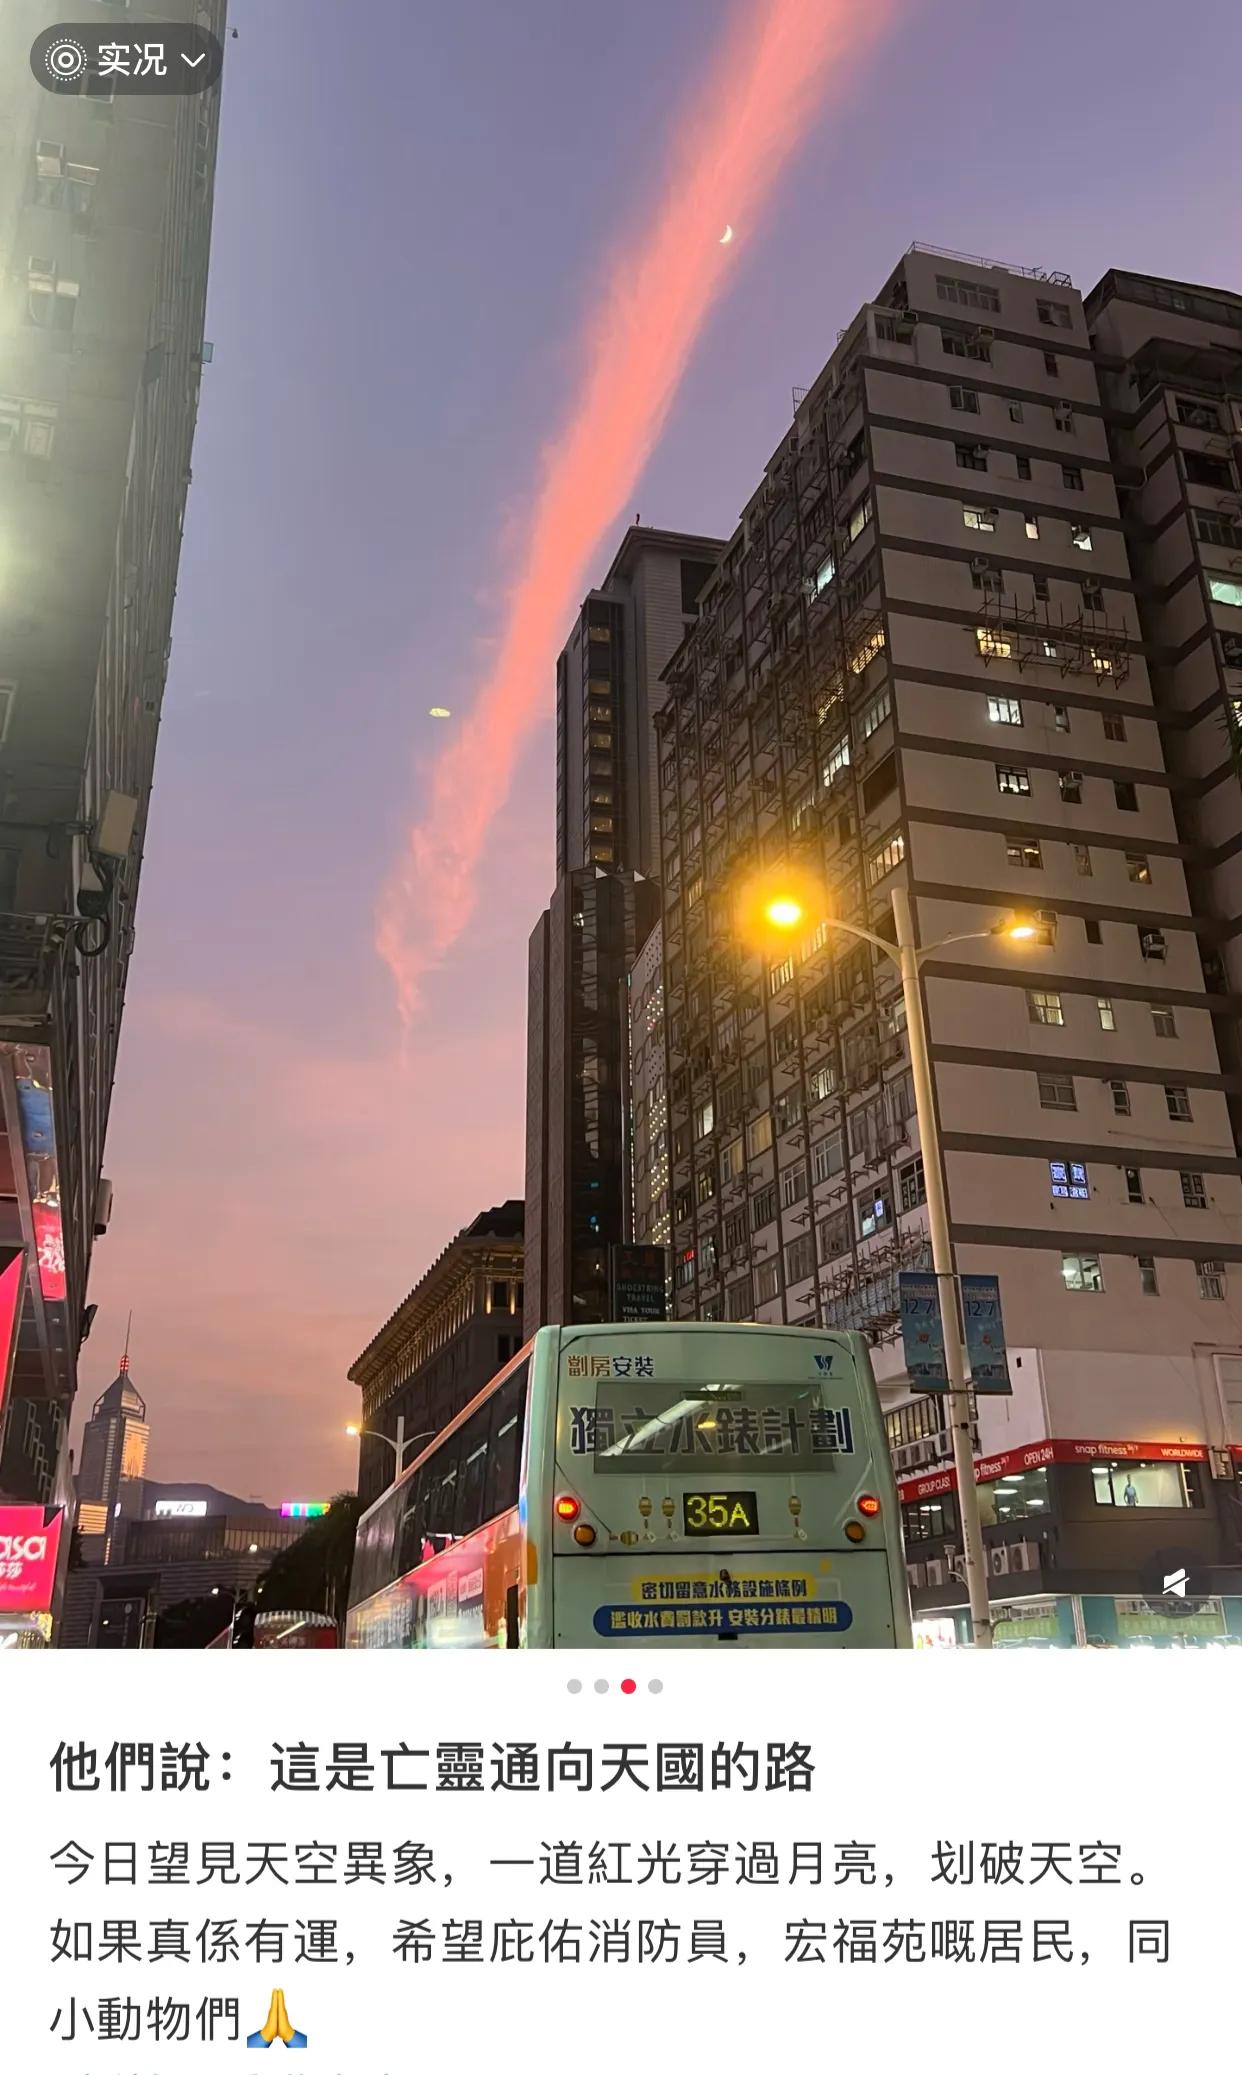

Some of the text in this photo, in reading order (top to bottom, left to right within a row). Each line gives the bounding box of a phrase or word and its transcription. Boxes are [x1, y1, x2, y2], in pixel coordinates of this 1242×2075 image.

[567, 1355, 655, 1377] 劏房安裝
[569, 1405, 856, 1456] 獨立水錶計劃
[1024, 1451, 1041, 1466] OPEN
[1075, 1445, 1097, 1456] snap
[1098, 1444, 1128, 1456] fitness
[1160, 1448, 1204, 1458] WORLDWIDE
[687, 1495, 750, 1528] 35A
[641, 1579, 807, 1600] 密切留意水務設施條例
